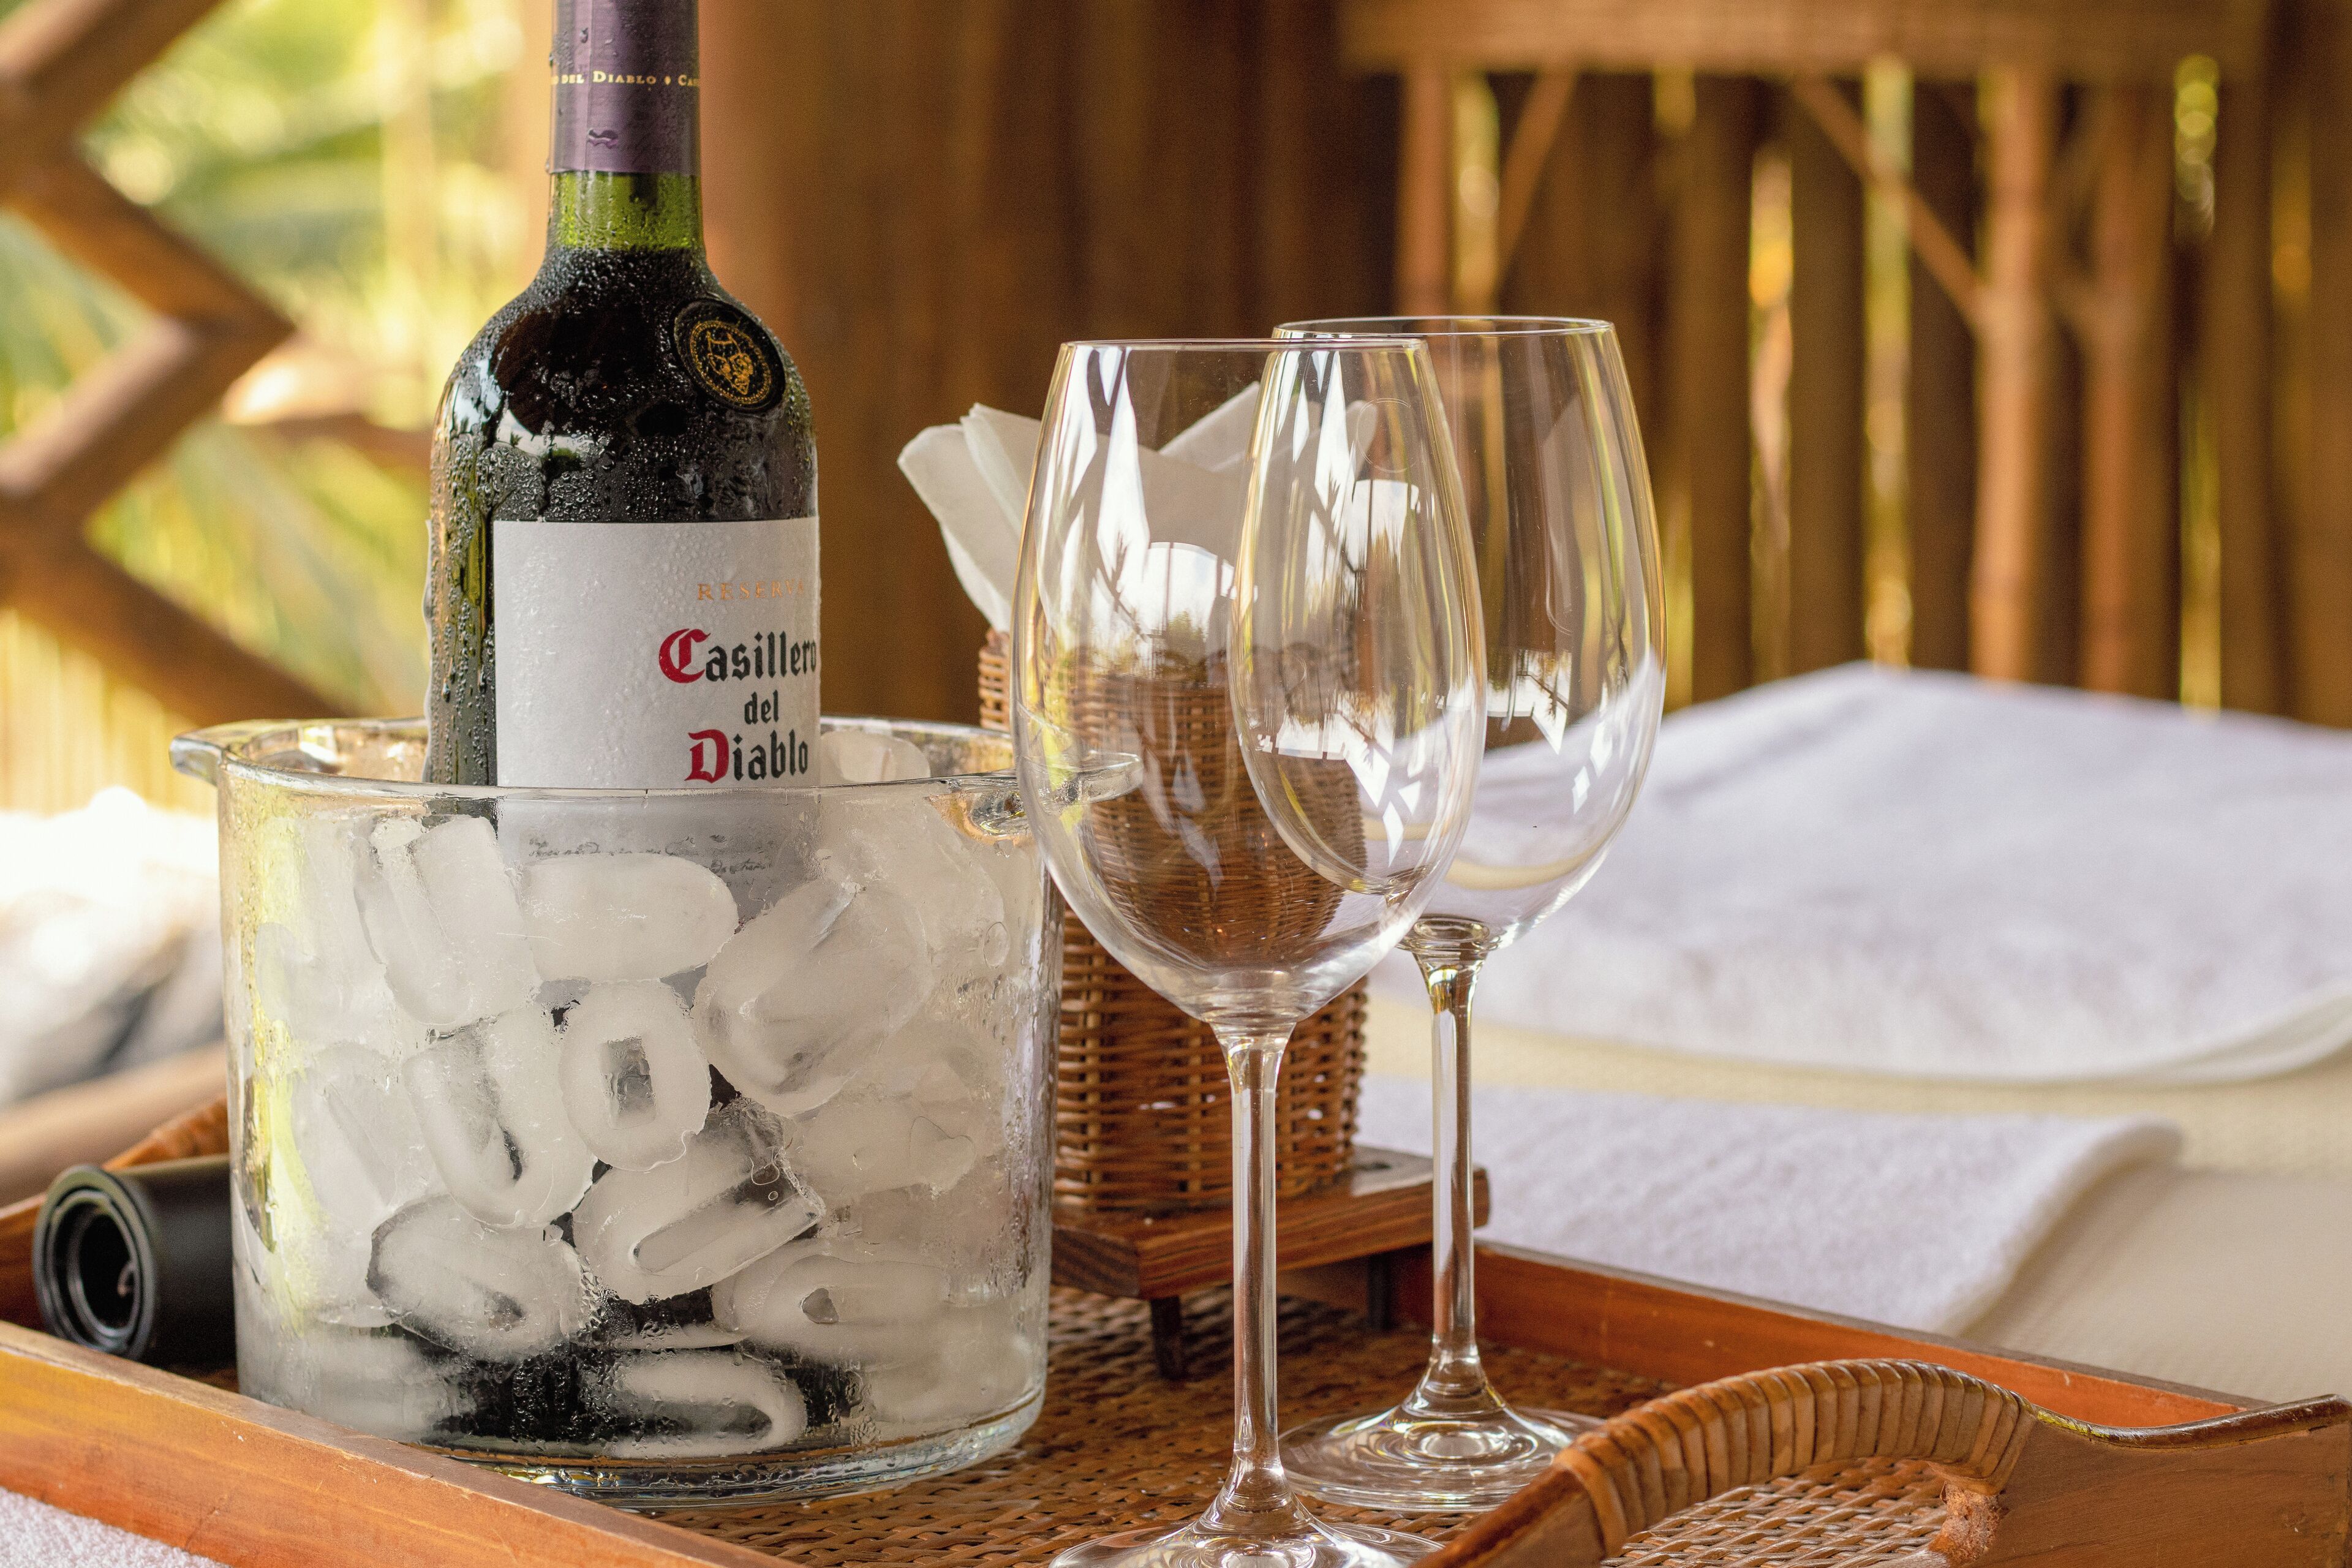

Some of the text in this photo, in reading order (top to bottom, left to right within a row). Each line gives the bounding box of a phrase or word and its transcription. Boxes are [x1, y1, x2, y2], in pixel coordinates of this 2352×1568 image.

[592, 70, 657, 85] DIABLO
[658, 628, 817, 684] Casillero
[744, 689, 780, 725] del
[684, 728, 809, 784] Diablo
